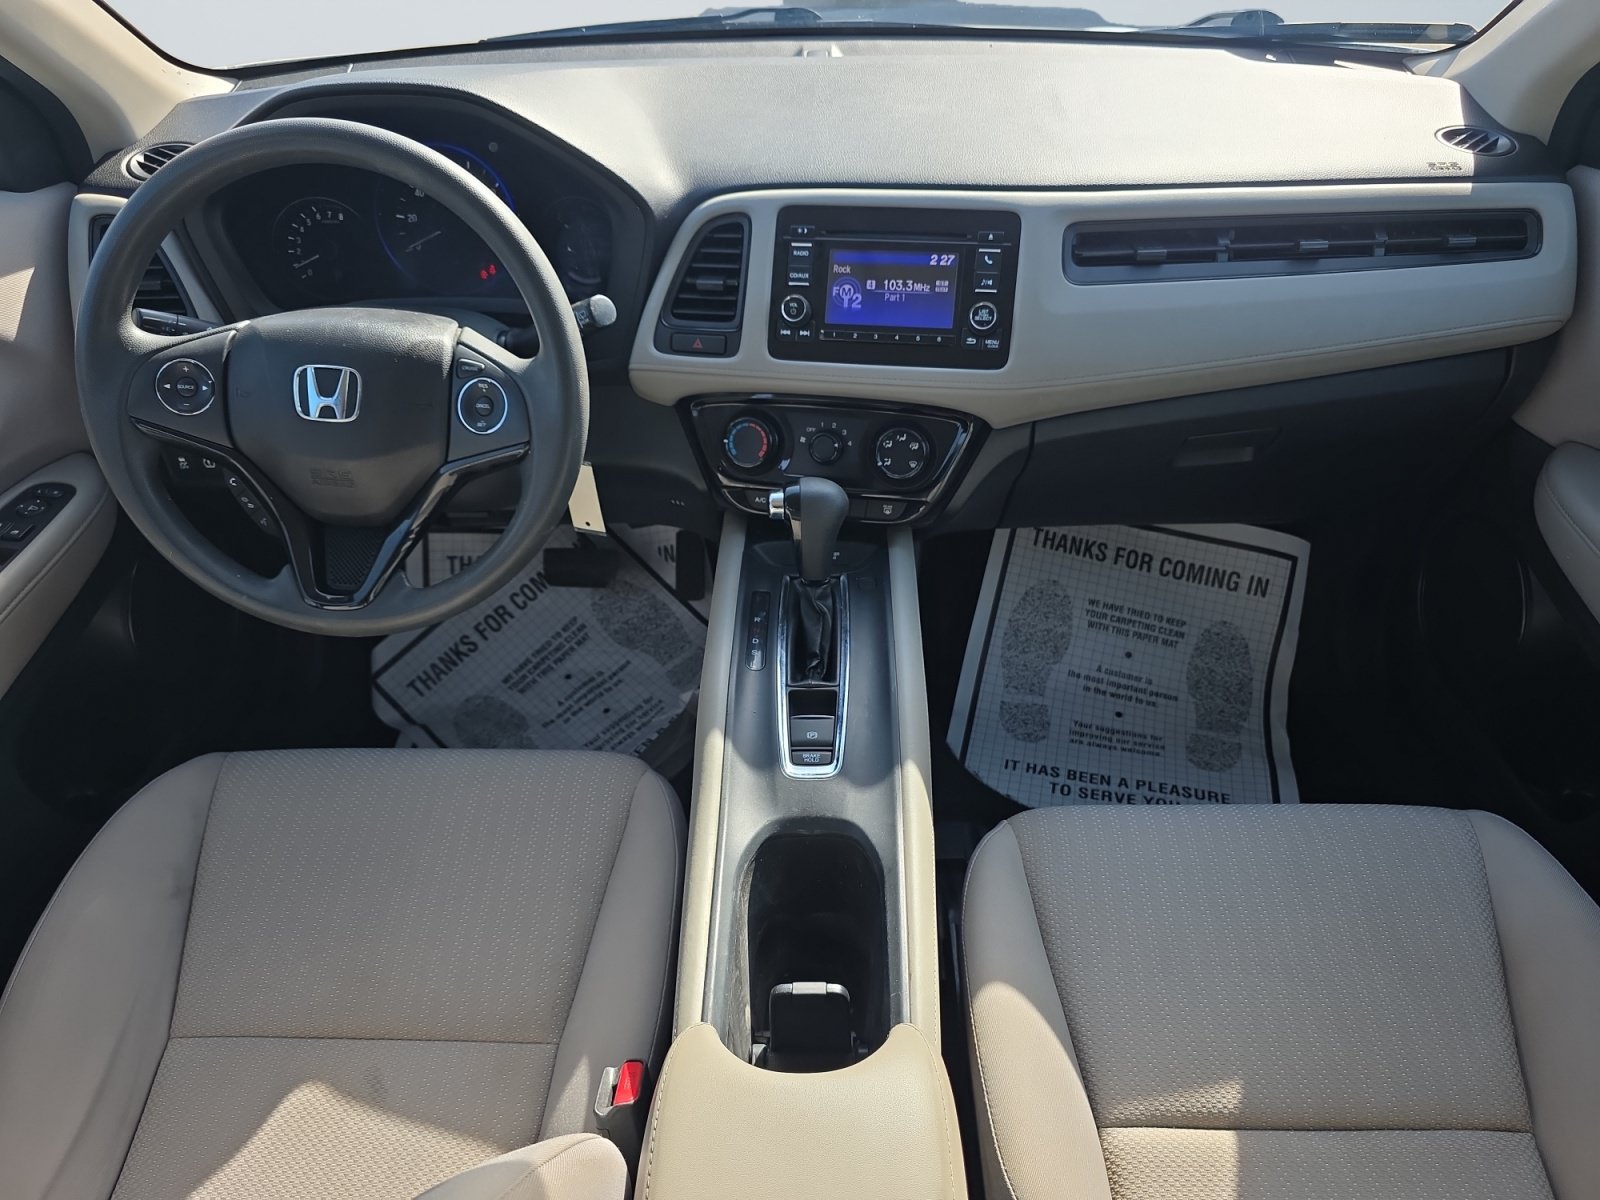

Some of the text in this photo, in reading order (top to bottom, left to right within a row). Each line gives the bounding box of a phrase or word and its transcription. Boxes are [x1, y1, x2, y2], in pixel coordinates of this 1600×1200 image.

[833, 264, 851, 274] Rock
[883, 280, 913, 291] 103.3
[913, 282, 931, 293] MHz
[884, 293, 900, 302] Part
[1032, 527, 1270, 598] THANKS FOR COMING IN
[1085, 608, 1185, 640] YOUR CARPETING CLEAN
[1088, 598, 1187, 628] WE HAVE TRIED TO KEEP
[1087, 620, 1179, 649] WITH THIS PAPER MAT
[406, 634, 479, 698] THANKS
[473, 604, 515, 641] FOR
[1068, 669, 1081, 679] the
[1083, 675, 1104, 685] most
[1106, 677, 1148, 695] important
[1004, 759, 1231, 804] IT HAS BEEN A PLEASURE
[1050, 782, 1071, 797] TO
[1078, 787, 1138, 805] SERVE
